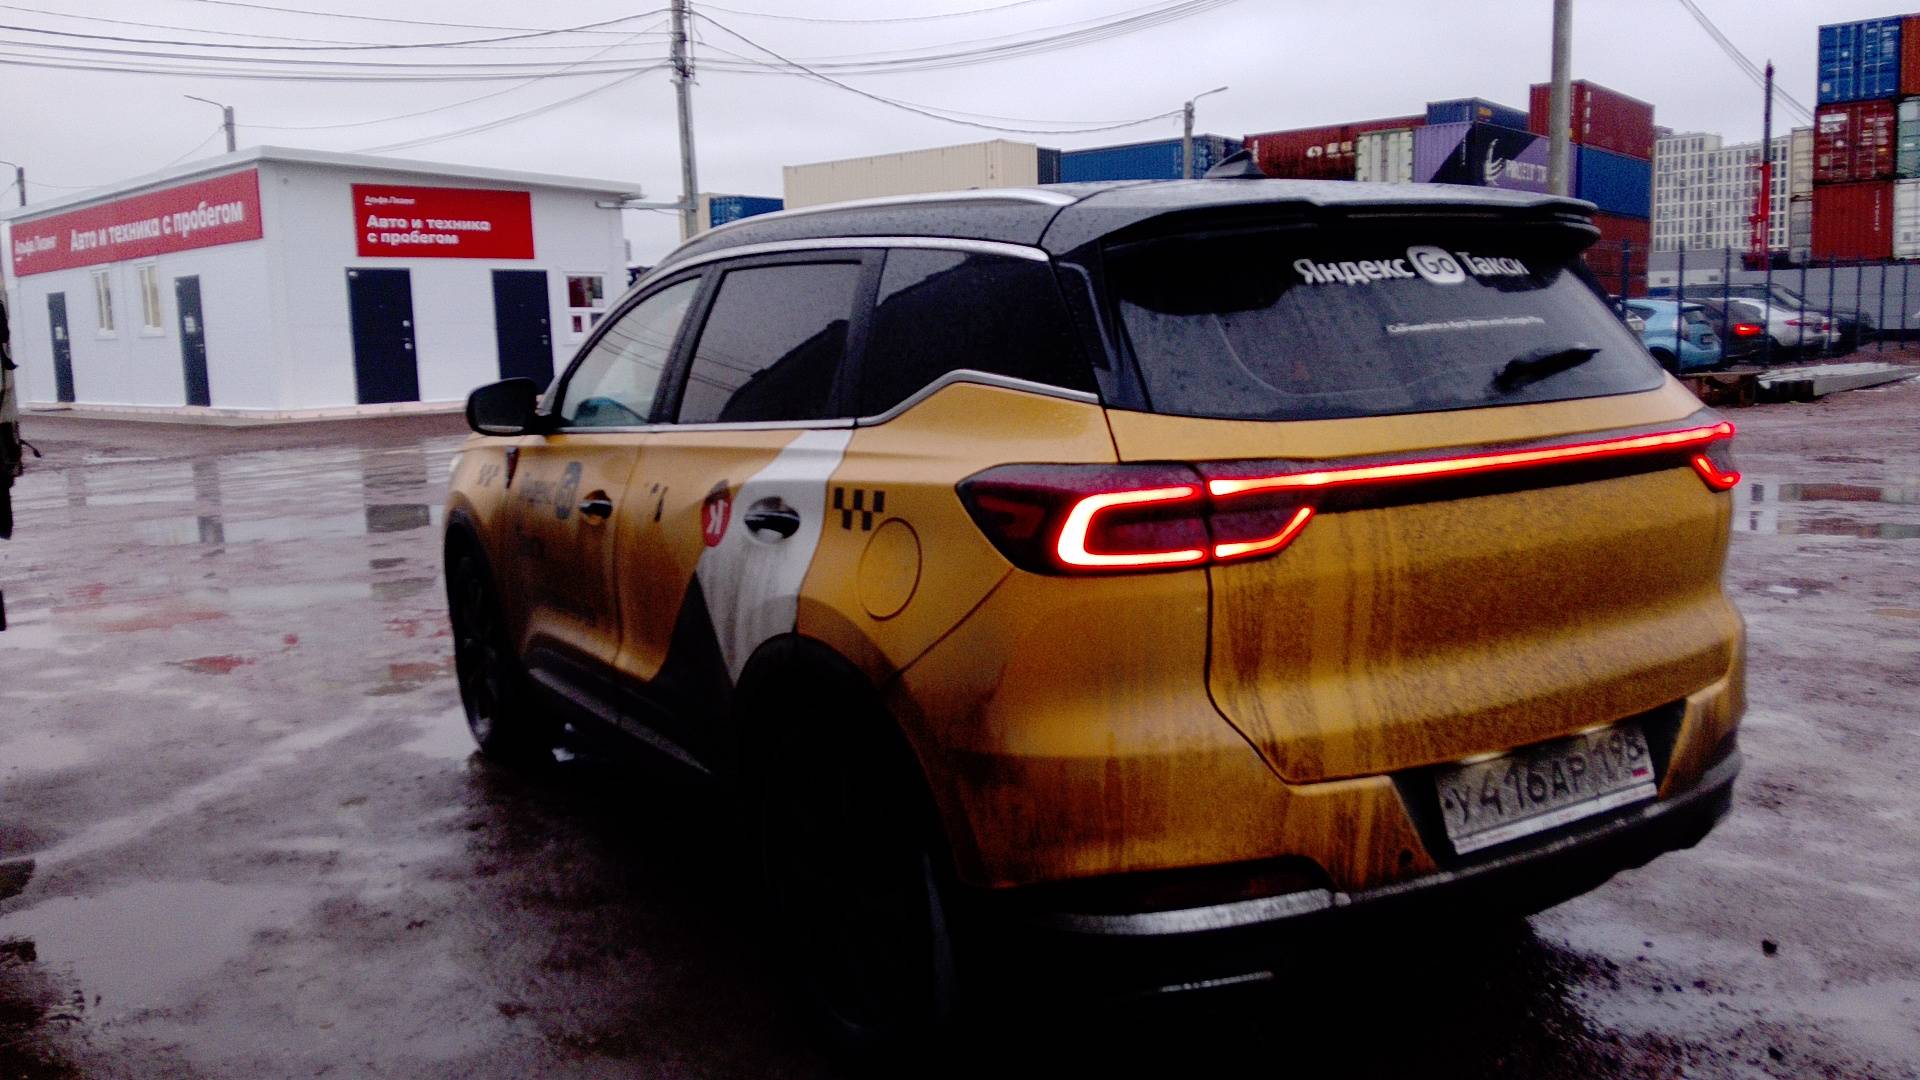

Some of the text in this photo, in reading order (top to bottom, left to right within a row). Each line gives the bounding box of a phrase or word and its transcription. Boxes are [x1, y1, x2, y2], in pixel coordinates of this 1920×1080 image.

[70, 201, 243, 252] Авто и техника с пробегом
[366, 215, 491, 231] Авто и техника
[367, 230, 459, 246] с пробегом
[1293, 257, 1416, 285] Яндекс
[1455, 251, 1530, 276] Такси
